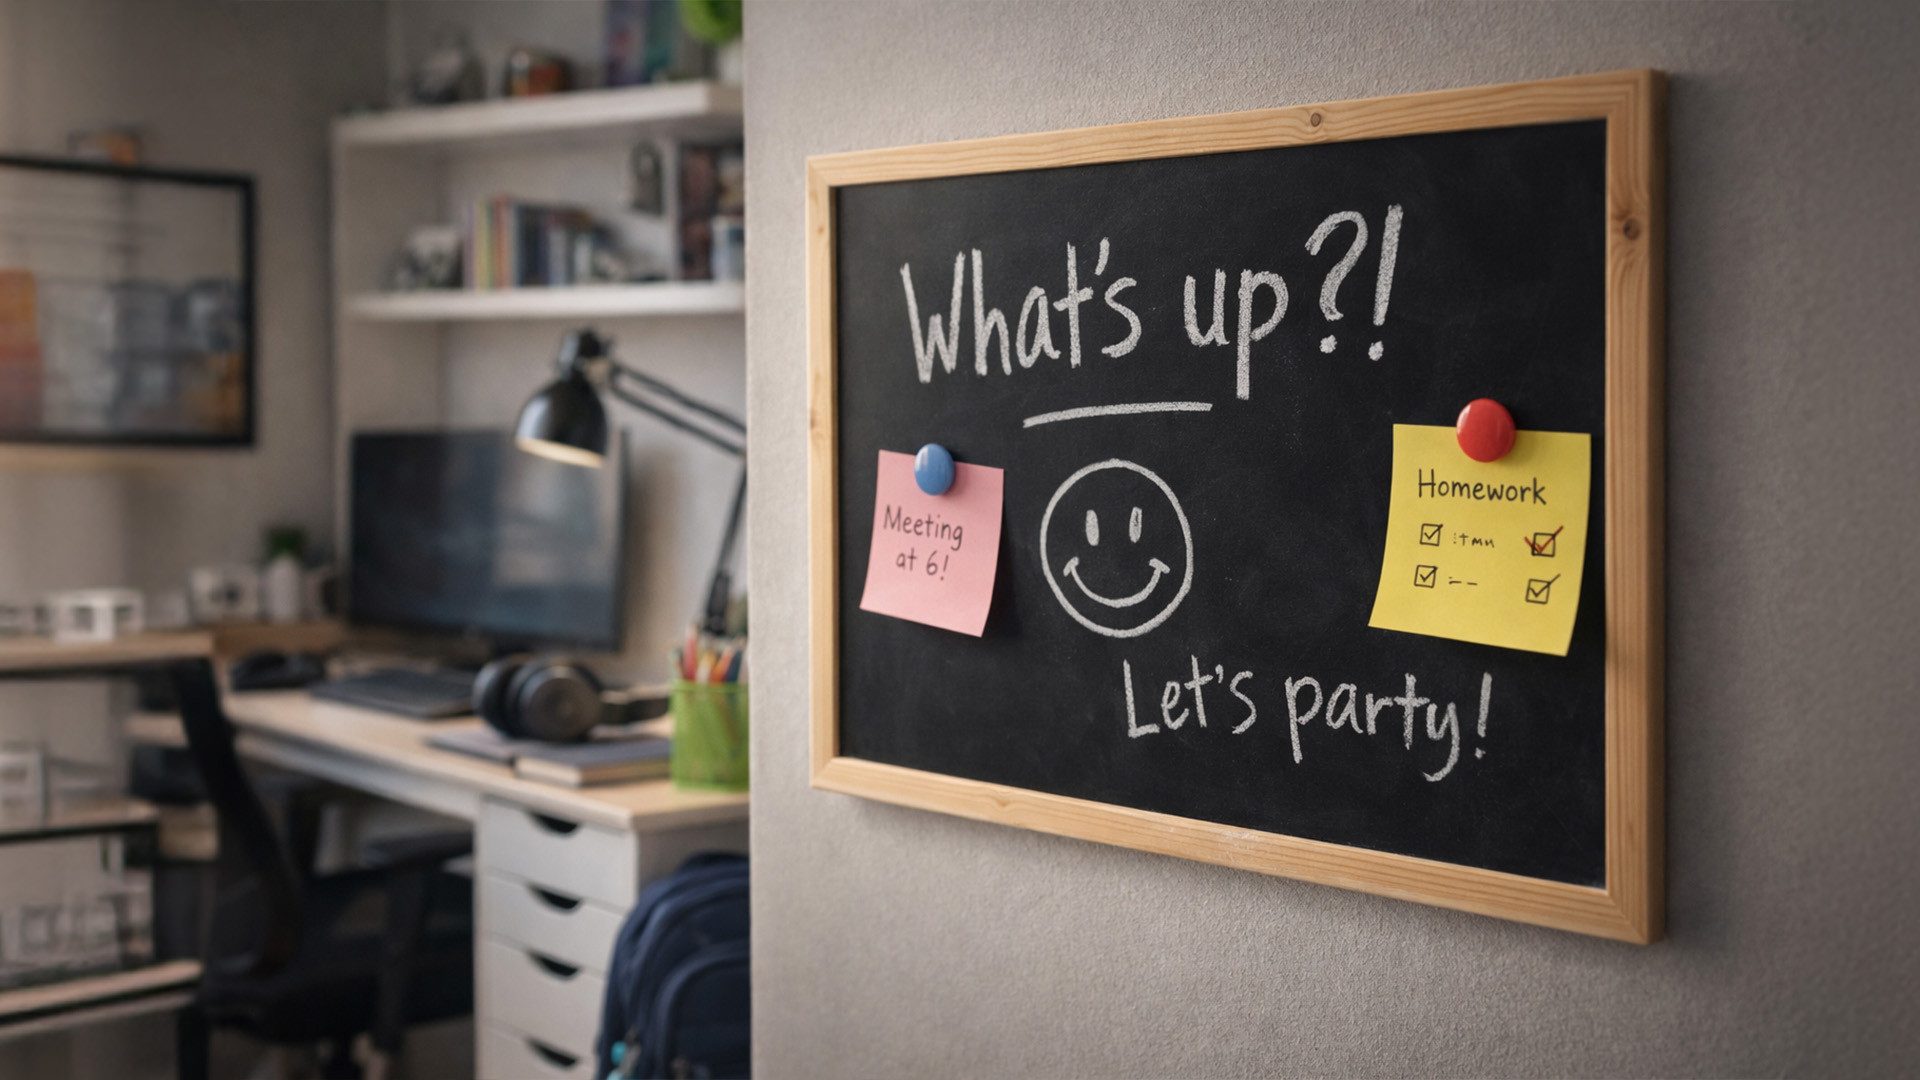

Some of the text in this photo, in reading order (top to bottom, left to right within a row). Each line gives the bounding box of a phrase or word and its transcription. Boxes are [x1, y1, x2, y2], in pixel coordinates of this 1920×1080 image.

[900, 236, 1142, 383] What's
[1417, 468, 1547, 506] Homework
[883, 504, 963, 551] Meeting
[896, 547, 949, 581] at 6!
[1123, 654, 1492, 782] Let's party!
